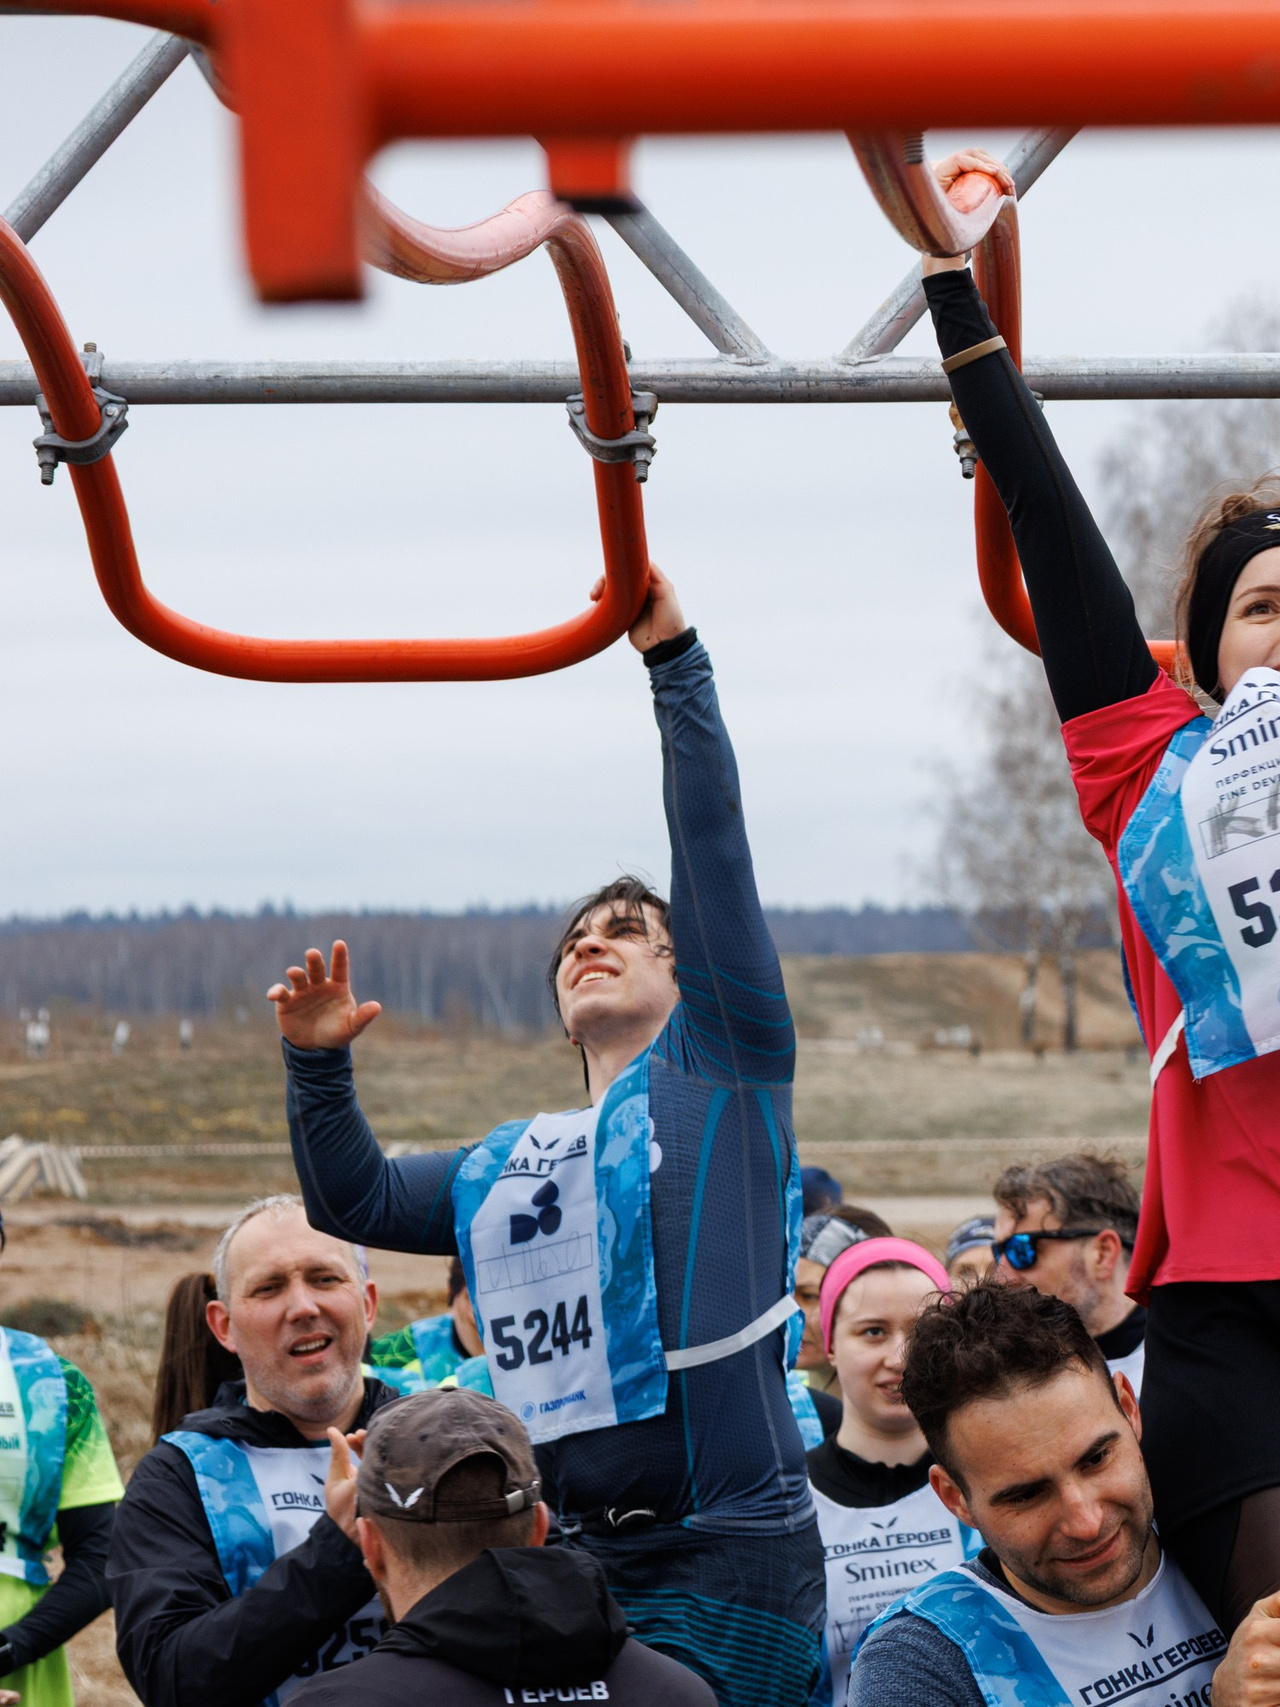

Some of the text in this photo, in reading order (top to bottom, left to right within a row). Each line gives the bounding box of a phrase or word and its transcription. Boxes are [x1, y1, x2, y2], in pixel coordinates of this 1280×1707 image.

[1219, 786, 1248, 803] FINE
[490, 1295, 592, 1371] 5244
[271, 1491, 323, 1507] ГОНКА
[825, 1528, 951, 1557] ГОНКА ГЕРОЕВ
[845, 1558, 938, 1584] Sminex
[1079, 1628, 1227, 1705] ГОНКА ГЕРОЕВ
